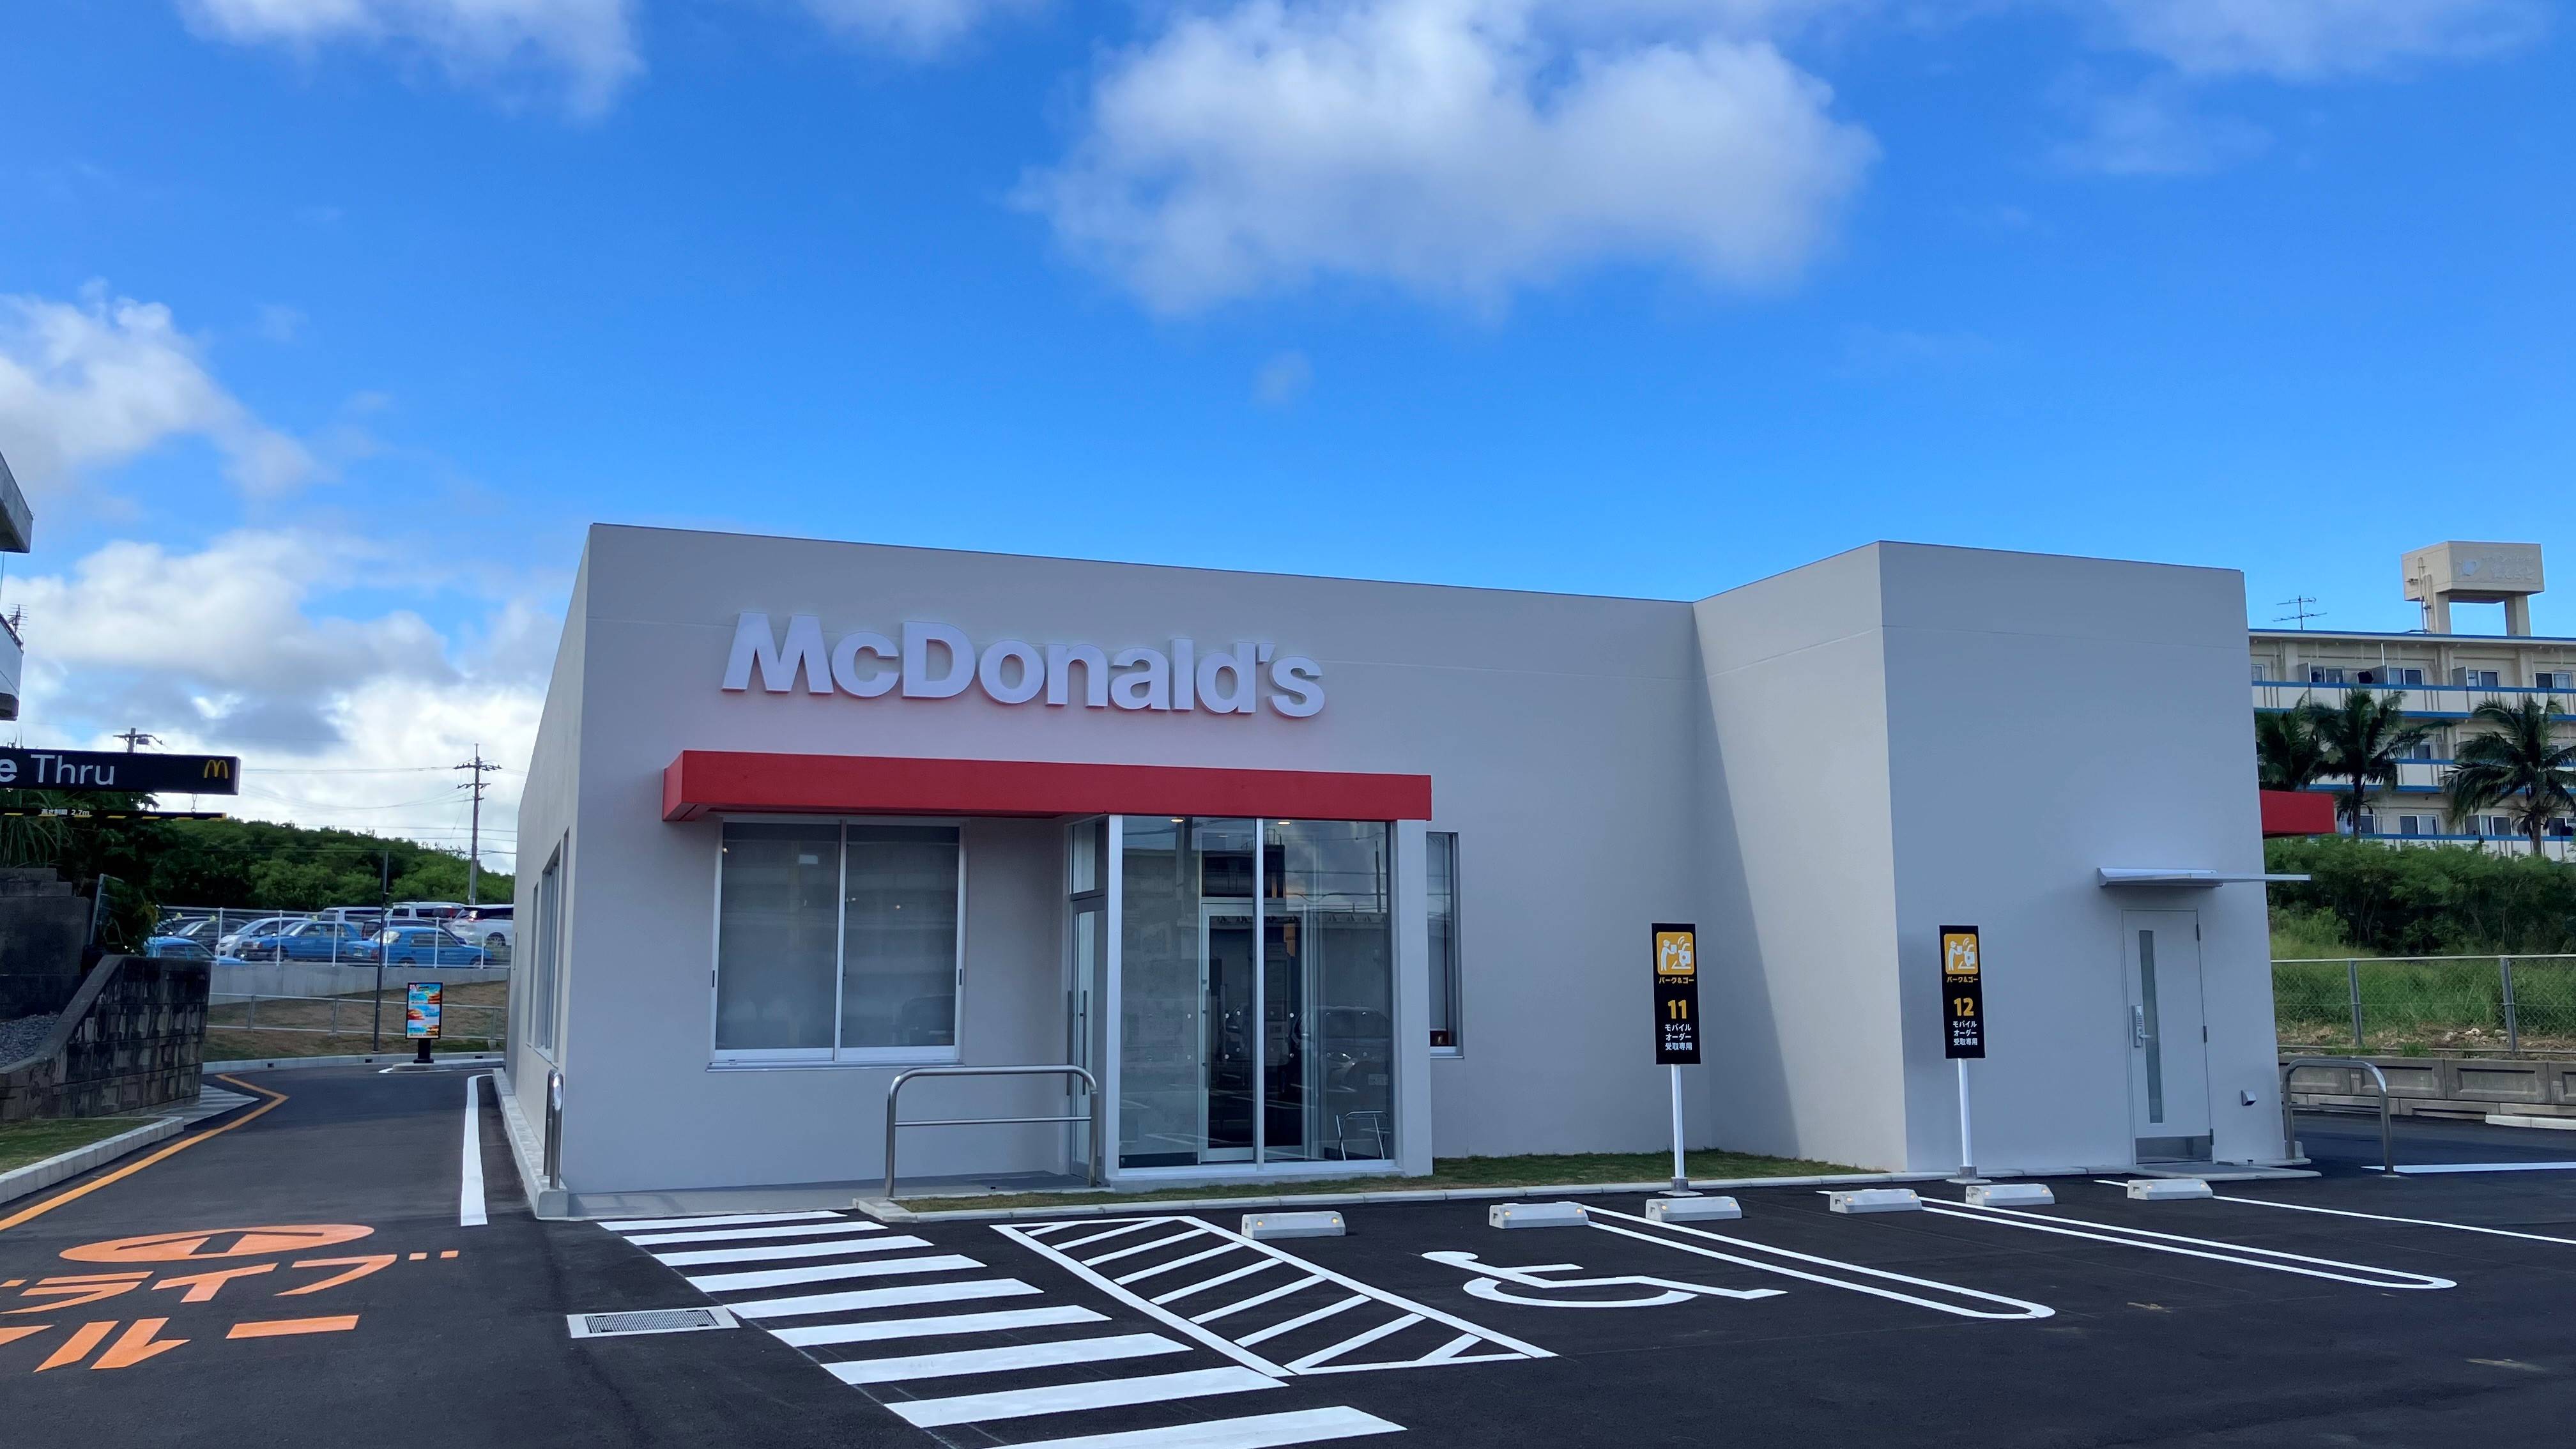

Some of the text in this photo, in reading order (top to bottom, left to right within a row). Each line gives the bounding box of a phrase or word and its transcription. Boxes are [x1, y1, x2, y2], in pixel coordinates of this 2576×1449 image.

[721, 611, 1326, 718] McDonald's
[31, 754, 115, 786] Thru
[1667, 999, 1687, 1019] 11
[1954, 997, 1974, 1016] 12
[1664, 1023, 1692, 1032] モバイル
[1665, 1032, 1692, 1041] オーダー
[1665, 1042, 1692, 1051] 受取専用
[1953, 1038, 1978, 1046] 受取専用
[0, 1250, 459, 1314] ライブ
[0, 1314, 360, 1372] ルー
